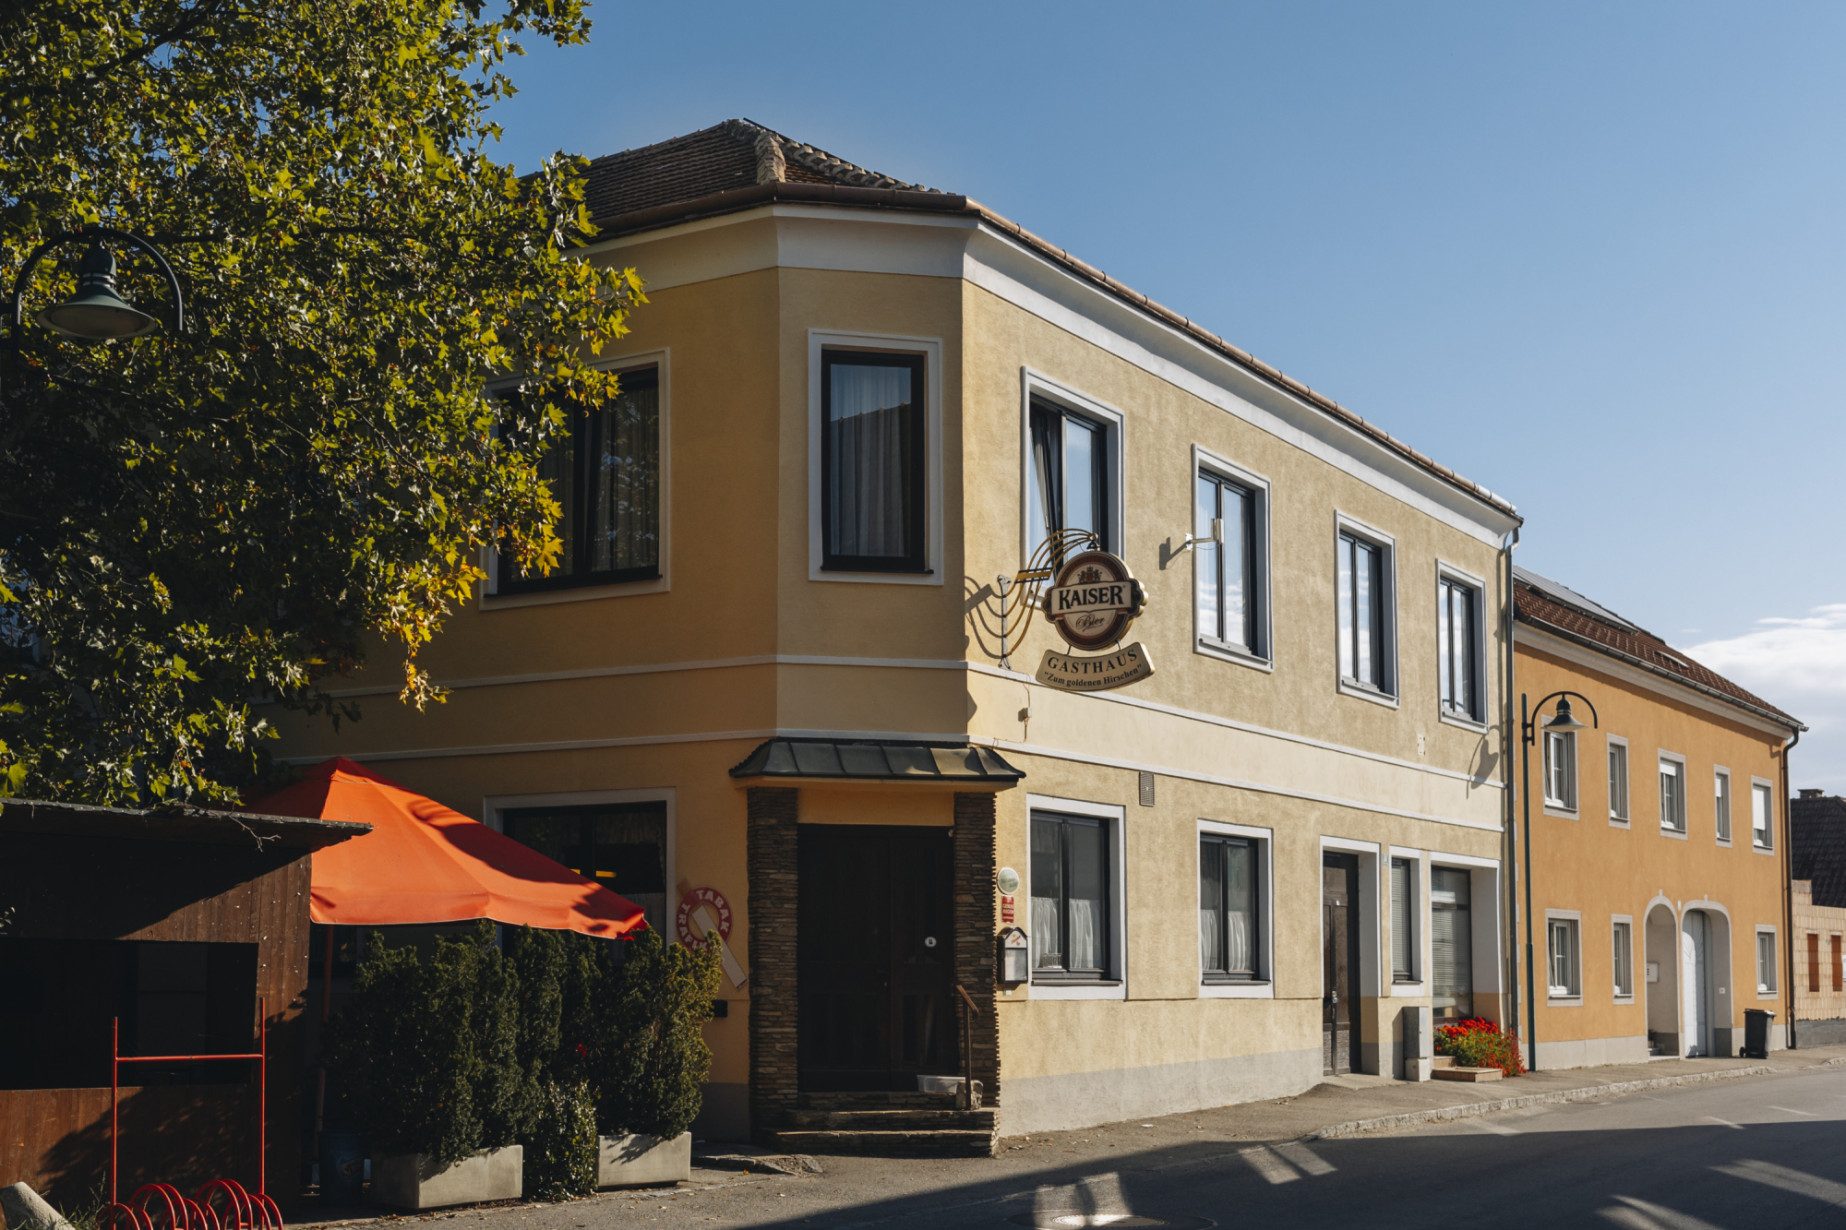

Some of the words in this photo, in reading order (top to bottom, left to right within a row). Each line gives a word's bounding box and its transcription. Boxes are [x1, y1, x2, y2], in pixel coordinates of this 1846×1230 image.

[1059, 585, 1124, 610] KAISER
[1048, 650, 1137, 673] GASTHAUS
[1066, 679, 1102, 688] goldenen
[696, 890, 729, 932] TABAK
